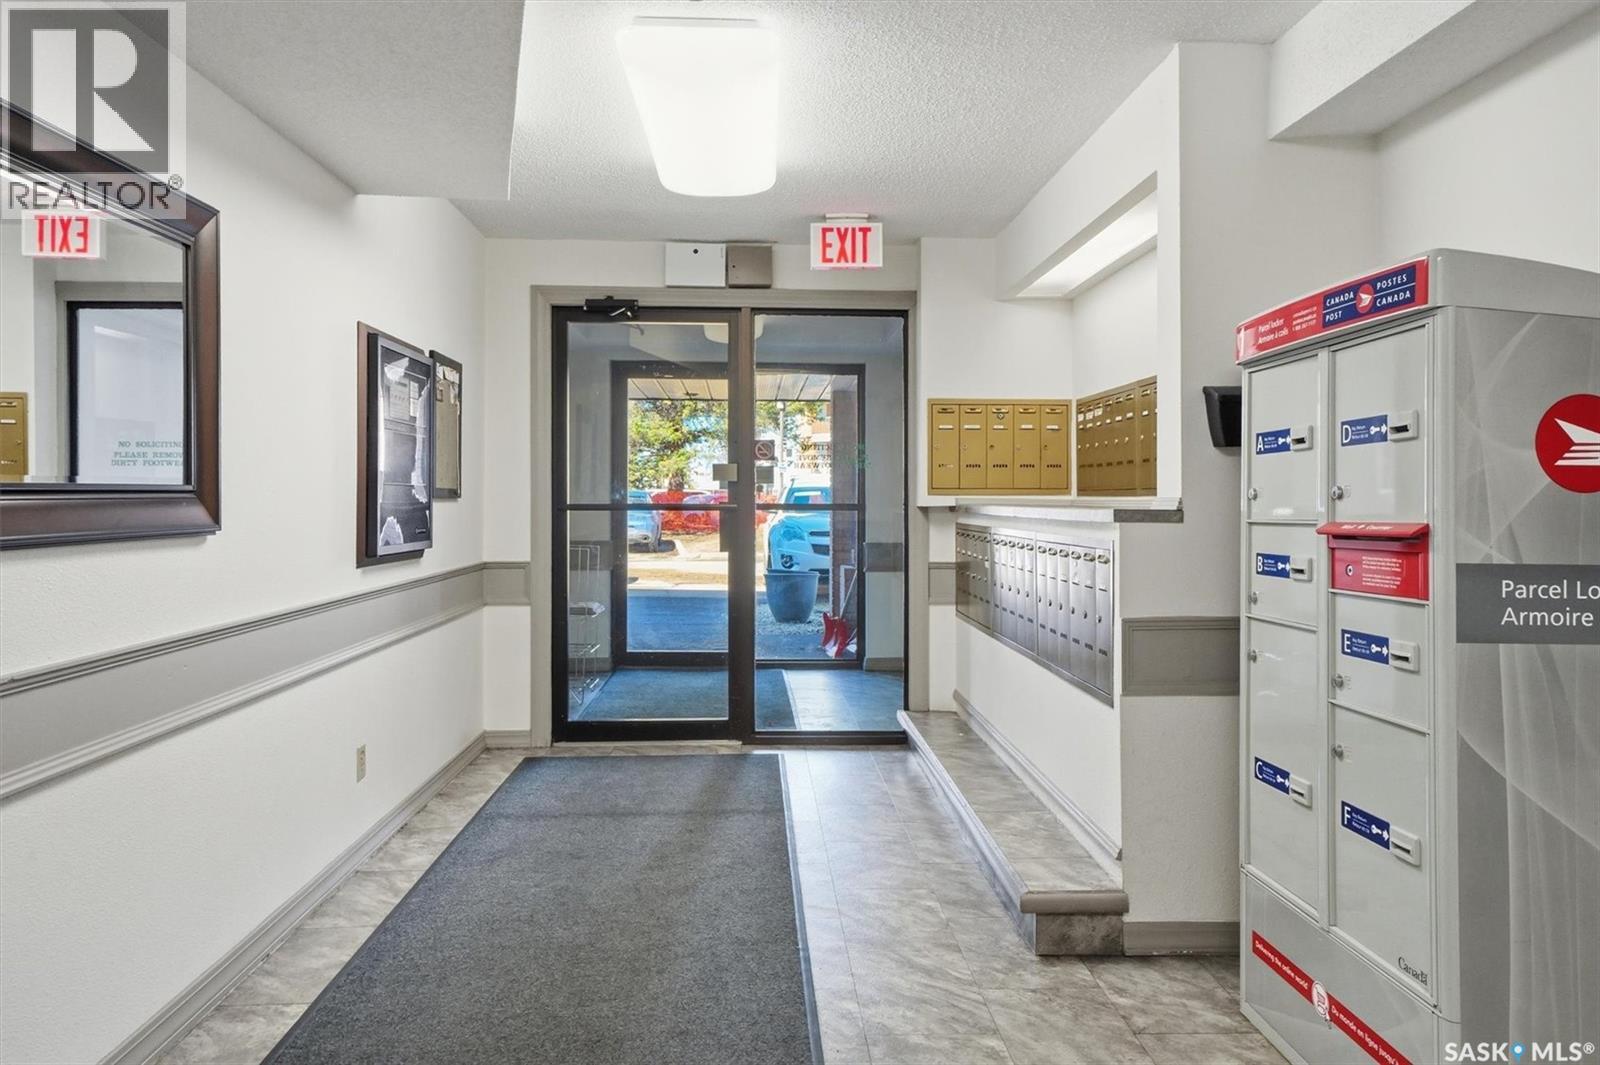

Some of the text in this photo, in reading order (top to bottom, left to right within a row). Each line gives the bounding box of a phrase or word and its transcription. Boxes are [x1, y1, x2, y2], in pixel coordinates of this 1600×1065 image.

[820, 226, 872, 264] EXIT
[1376, 273, 1408, 290] POSTES
[1325, 290, 1355, 307] CANADA
[1376, 290, 1411, 307] CANADA
[1325, 310, 1343, 323] POST
[1342, 424, 1352, 444] D
[118, 440, 131, 448] NO
[1256, 435, 1265, 452] A
[143, 459, 182, 467] FOOTWE
[1257, 555, 1263, 572] B
[1501, 579, 1600, 600] Parcel Lo
[1501, 607, 1594, 627] Armoire
[1344, 633, 1351, 653] E
[1256, 761, 1263, 779] C
[1344, 805, 1351, 825] F
